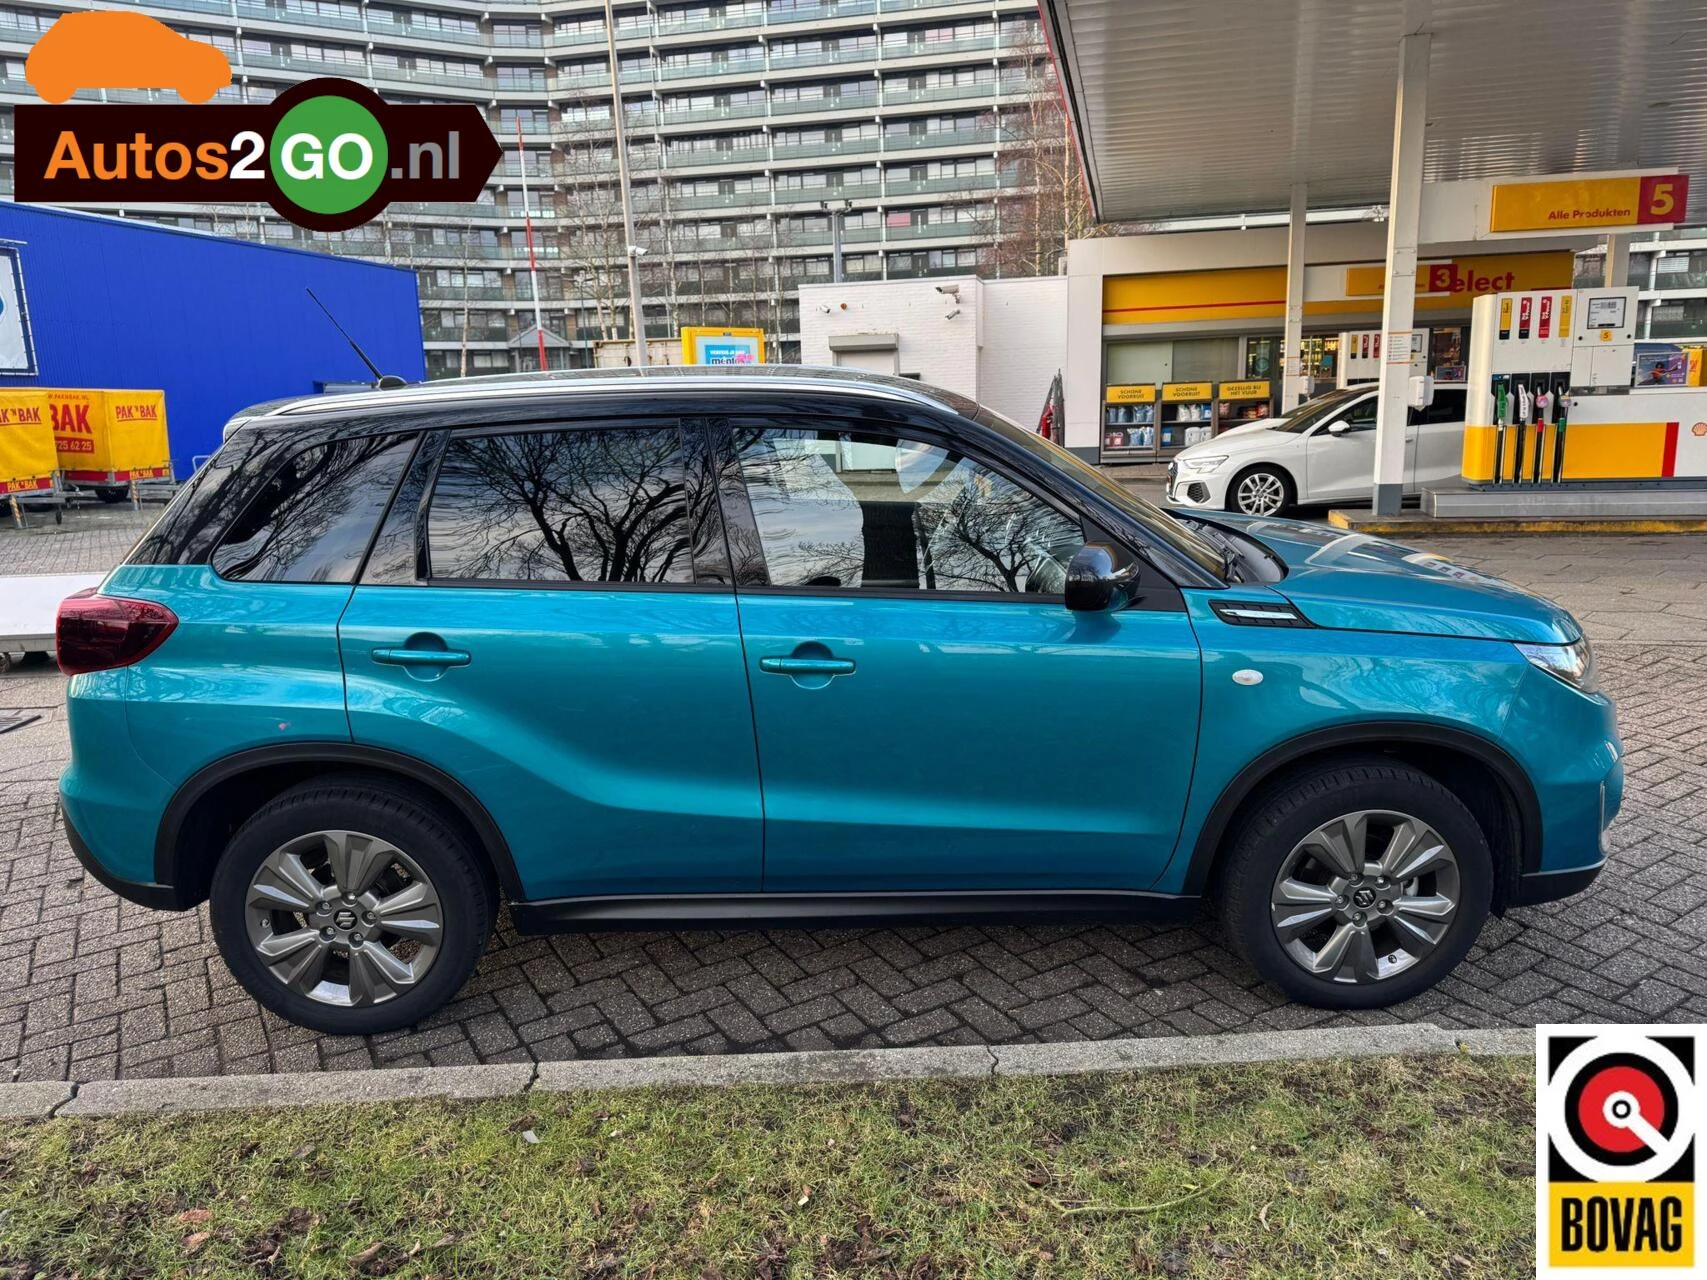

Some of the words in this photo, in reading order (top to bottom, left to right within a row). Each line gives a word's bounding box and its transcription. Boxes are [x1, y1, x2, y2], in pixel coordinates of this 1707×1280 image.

[1650, 184, 1674, 216] 5
[1548, 208, 1569, 220] Alle
[1572, 208, 1631, 219] Produkten
[1435, 269, 1450, 288] 3
[1453, 270, 1515, 293] elect
[18, 407, 41, 422] BAK
[115, 406, 134, 419] PAK
[140, 405, 157, 417] BAK
